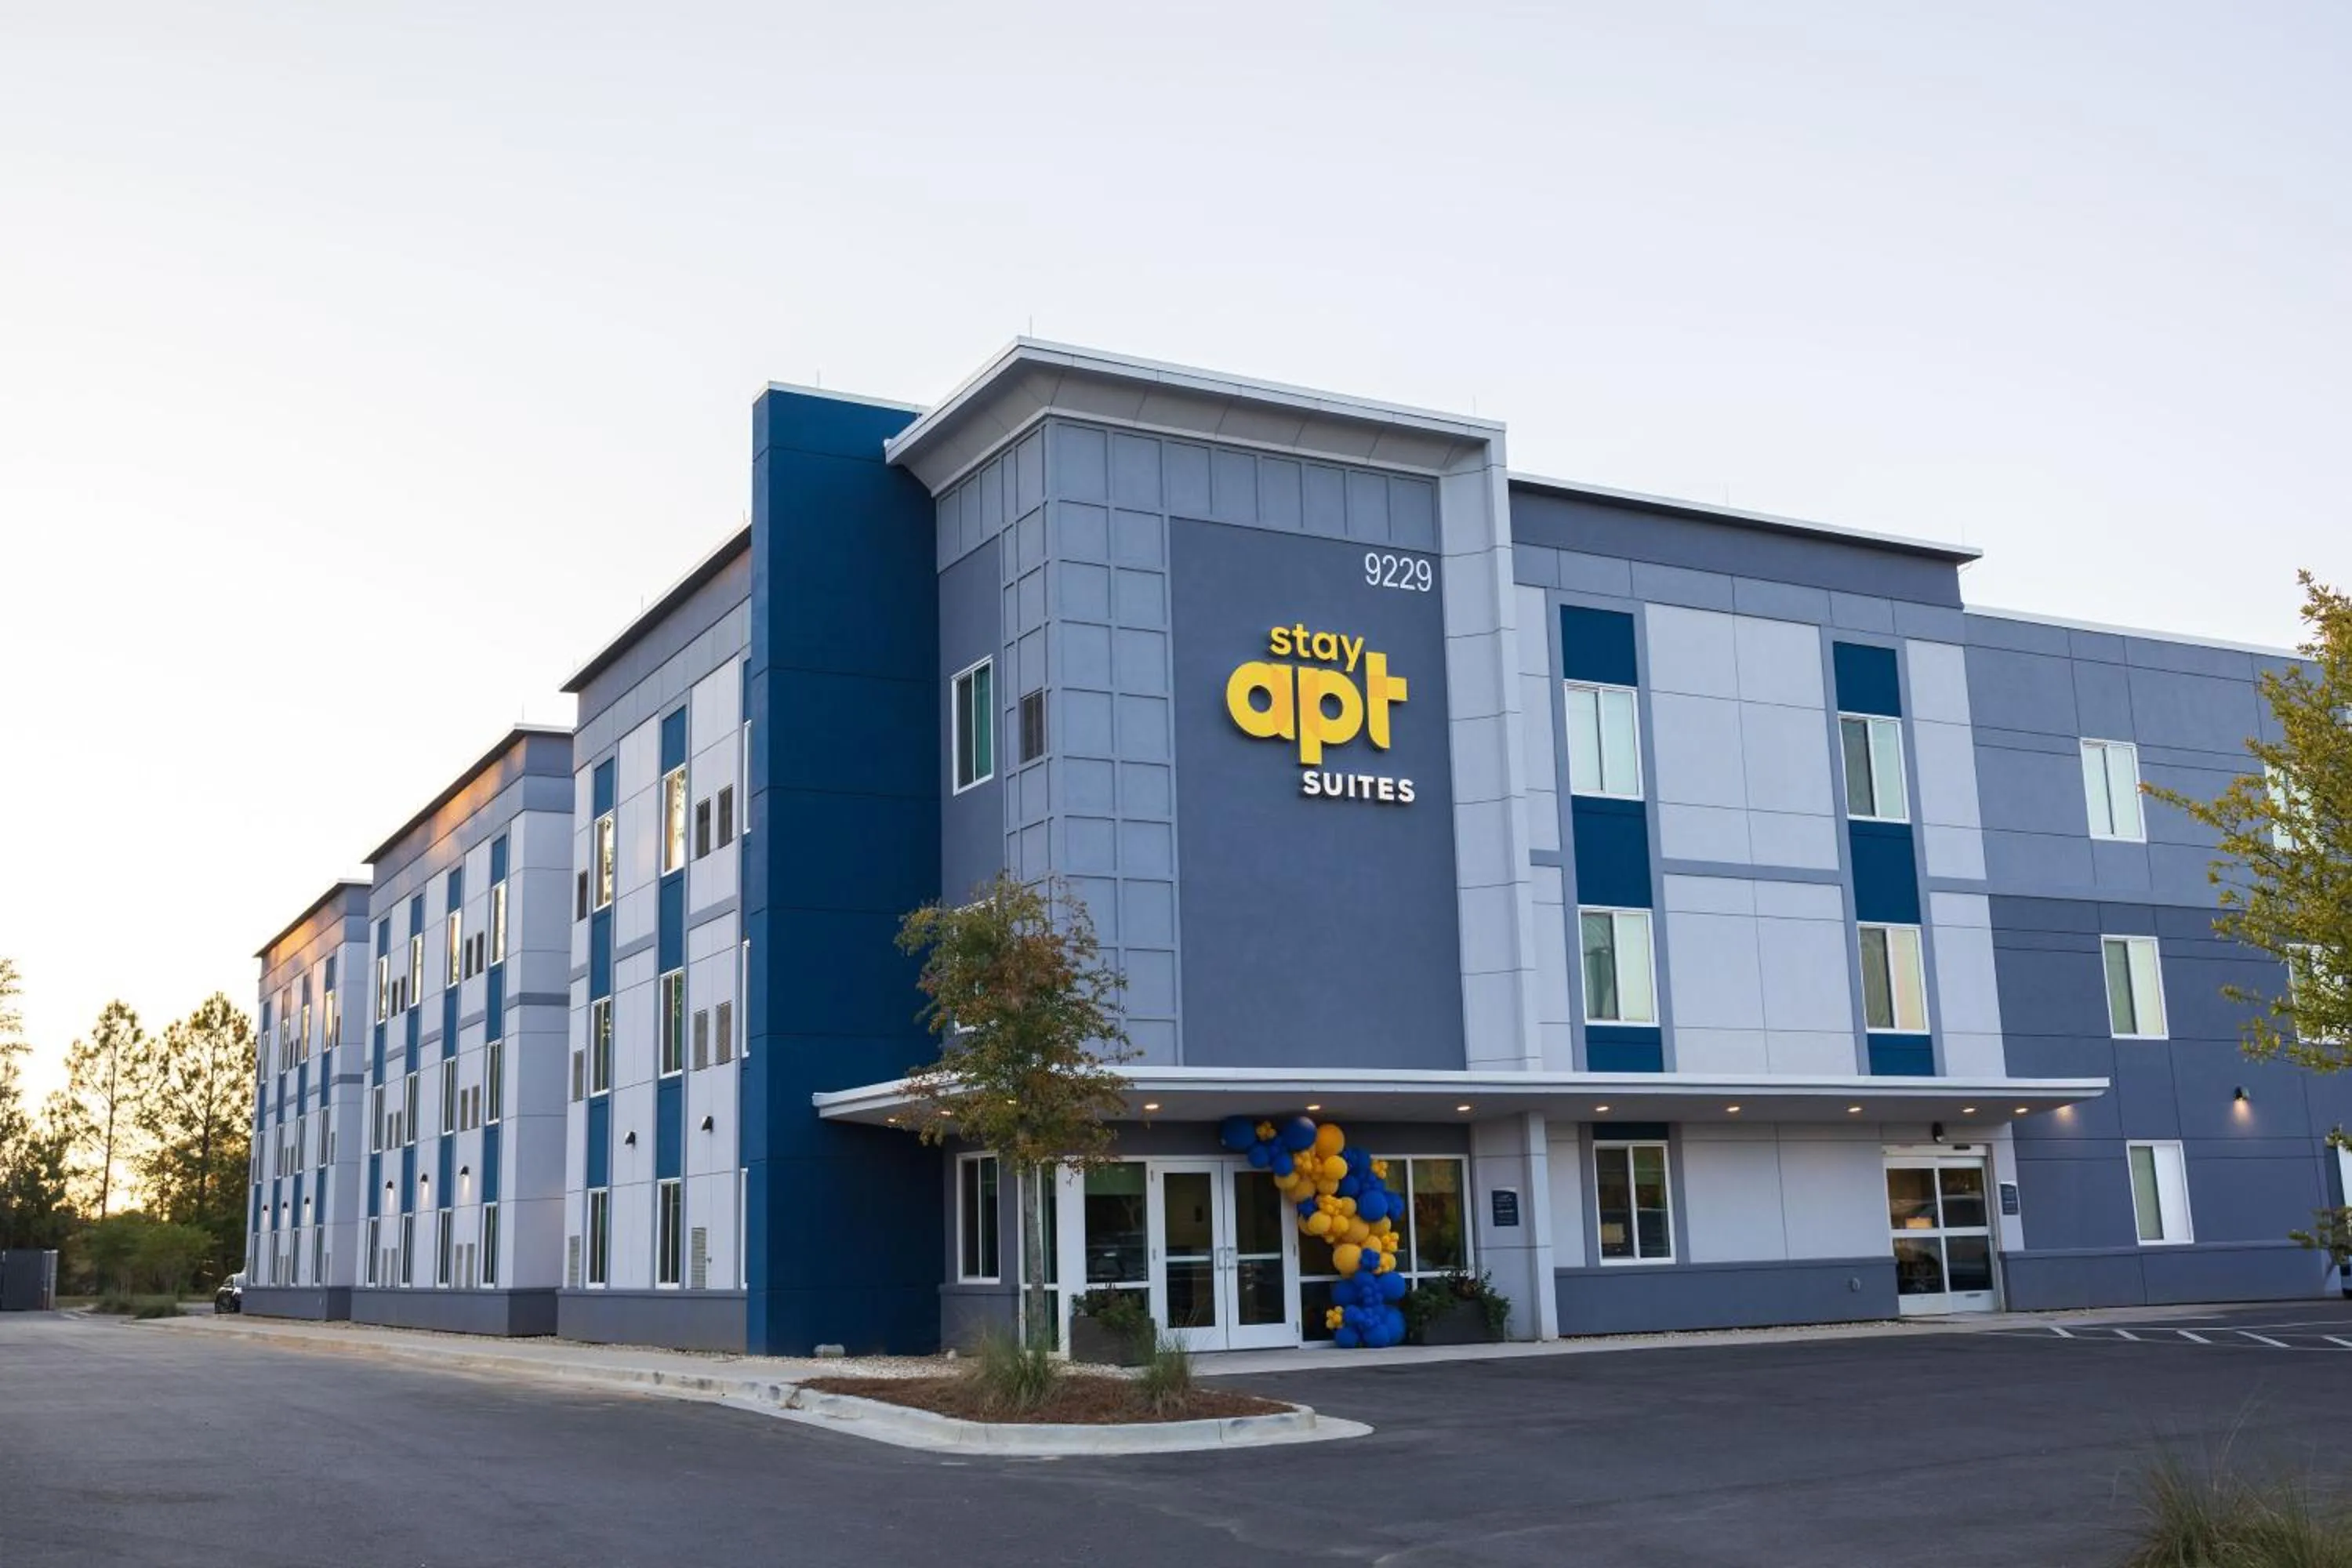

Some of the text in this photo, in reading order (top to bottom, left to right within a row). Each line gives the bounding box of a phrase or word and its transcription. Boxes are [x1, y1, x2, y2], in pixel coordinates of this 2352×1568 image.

[1365, 552, 1432, 592] 9229
[1269, 623, 1364, 672] stay
[1226, 652, 1407, 765] apt
[1302, 770, 1415, 803] SUITES
